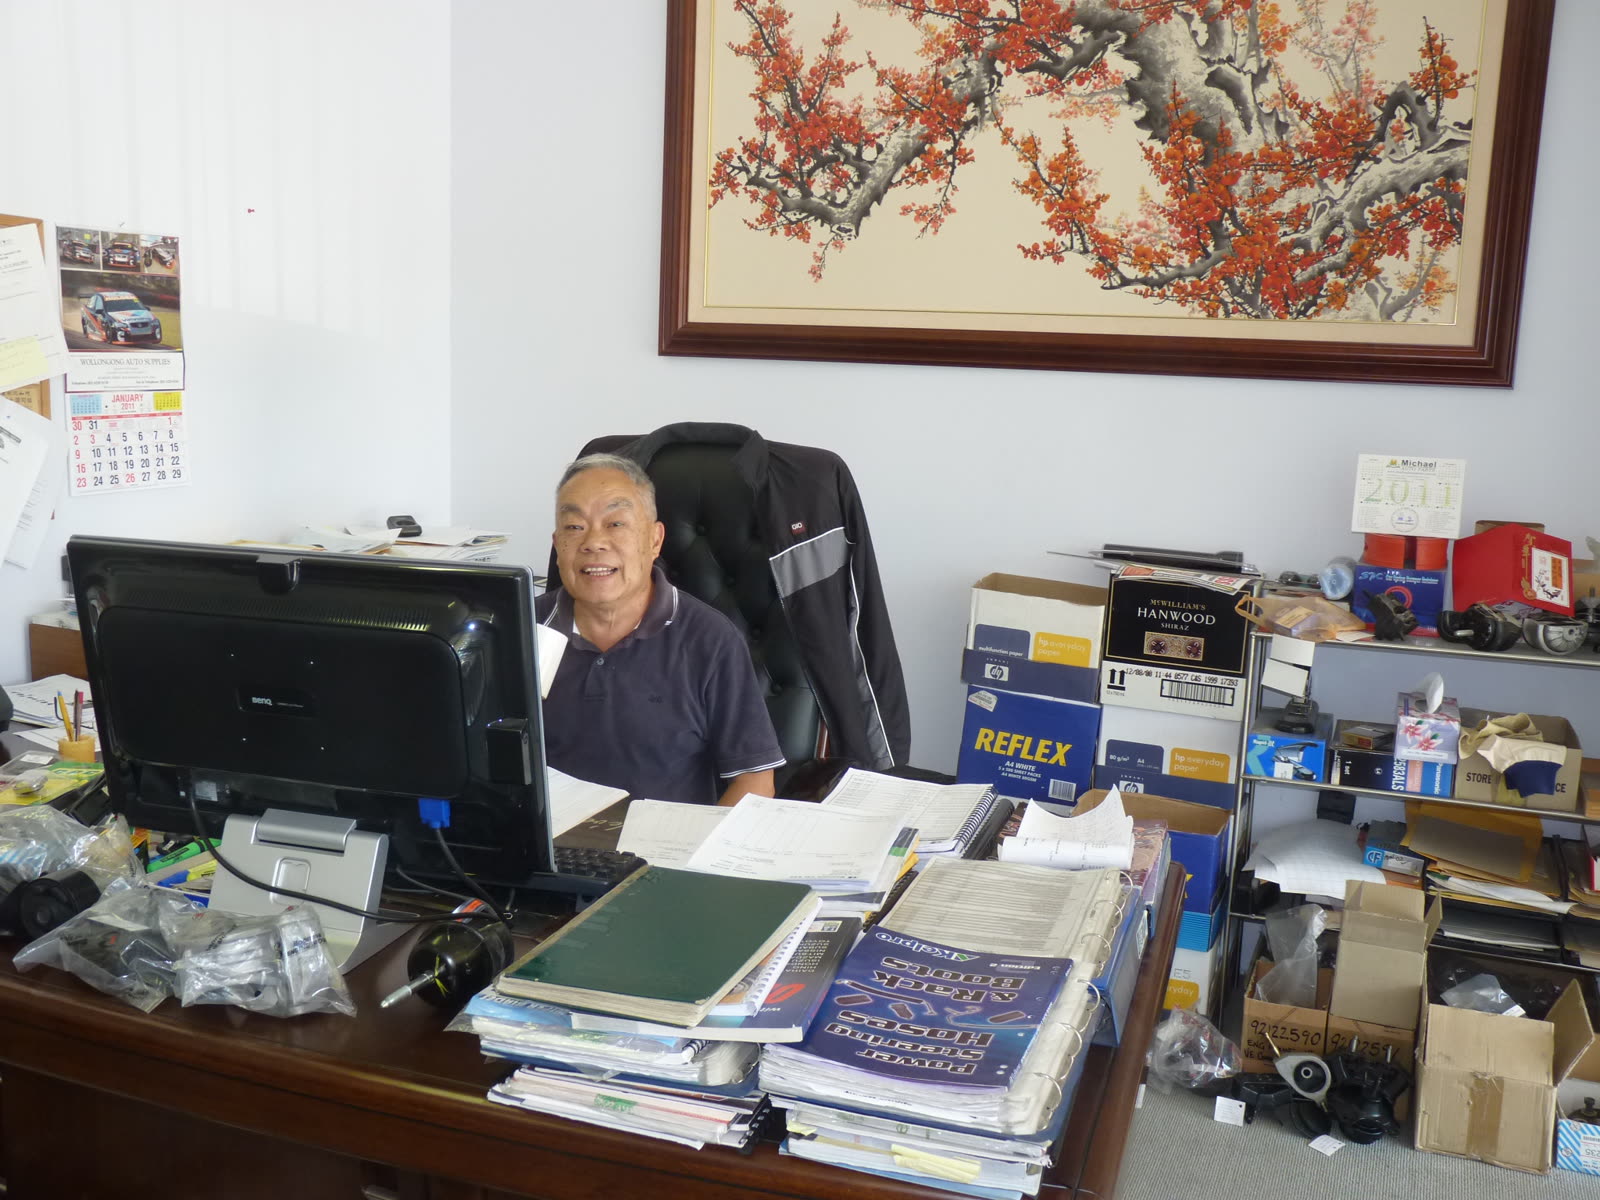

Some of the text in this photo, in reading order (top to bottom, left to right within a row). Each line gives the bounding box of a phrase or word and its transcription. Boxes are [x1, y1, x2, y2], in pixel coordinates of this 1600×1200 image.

[112, 394, 143, 403] JANUARY
[72, 421, 82, 430] 30
[89, 421, 98, 430] 31
[74, 430, 174, 445] 2 3 4 5 6 7 8
[75, 443, 179, 459] 9 10 11 12 13 14 15
[76, 456, 180, 473] 16 17 18 19 20 21 22
[1401, 460, 1437, 468] Michael
[77, 470, 181, 487] 23 24 25 26 27 28 29
[1363, 479, 1452, 507] 2011
[1137, 607, 1216, 625] HANWOOD
[1161, 623, 1190, 631] SHIRAZ
[1039, 637, 1086, 652] hp everyday
[1037, 648, 1060, 657] paper
[252, 697, 272, 706] BenQ
[974, 728, 1072, 766] REFLEX
[1016, 762, 1036, 772] WHITE
[1175, 753, 1225, 768] hp everyday
[1174, 764, 1198, 773] paper
[1434, 762, 1443, 795] Panasonic
[1466, 772, 1492, 784] STORE
[876, 932, 959, 960] Kelpro
[880, 956, 1025, 990] Boots
[1001, 963, 1041, 971] Edition
[870, 970, 1018, 1003] & Rack
[1167, 985, 1193, 997] ryday
[837, 1010, 995, 1048] Hoses
[1251, 1020, 1320, 1045] 92122590
[825, 1022, 985, 1061] Steering
[856, 1049, 977, 1075] Power
